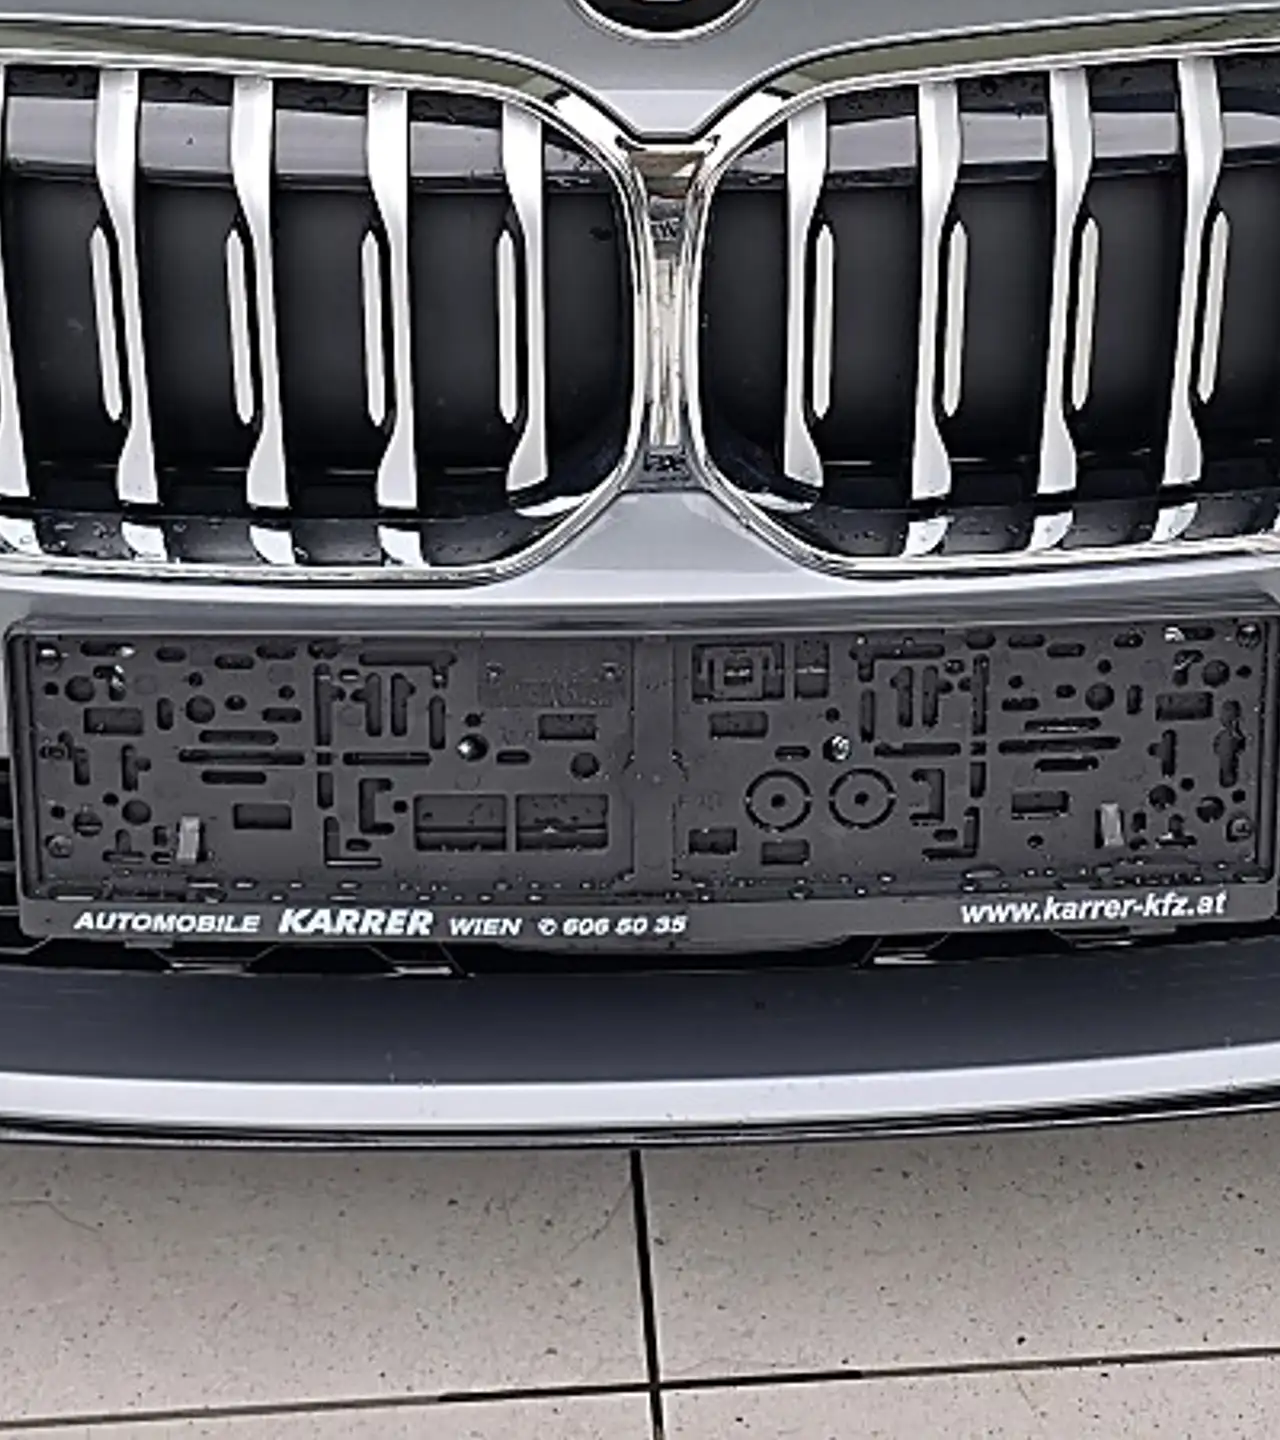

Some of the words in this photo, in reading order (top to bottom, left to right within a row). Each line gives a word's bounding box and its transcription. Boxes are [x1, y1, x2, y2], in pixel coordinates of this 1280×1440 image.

[73, 911, 261, 933] AUTOMOBILE
[278, 908, 434, 937] KARRER
[449, 917, 523, 937] WIEN
[562, 917, 610, 936] 606
[653, 914, 689, 934] 35
[960, 890, 1228, 924] www.karrer-kfz.at
